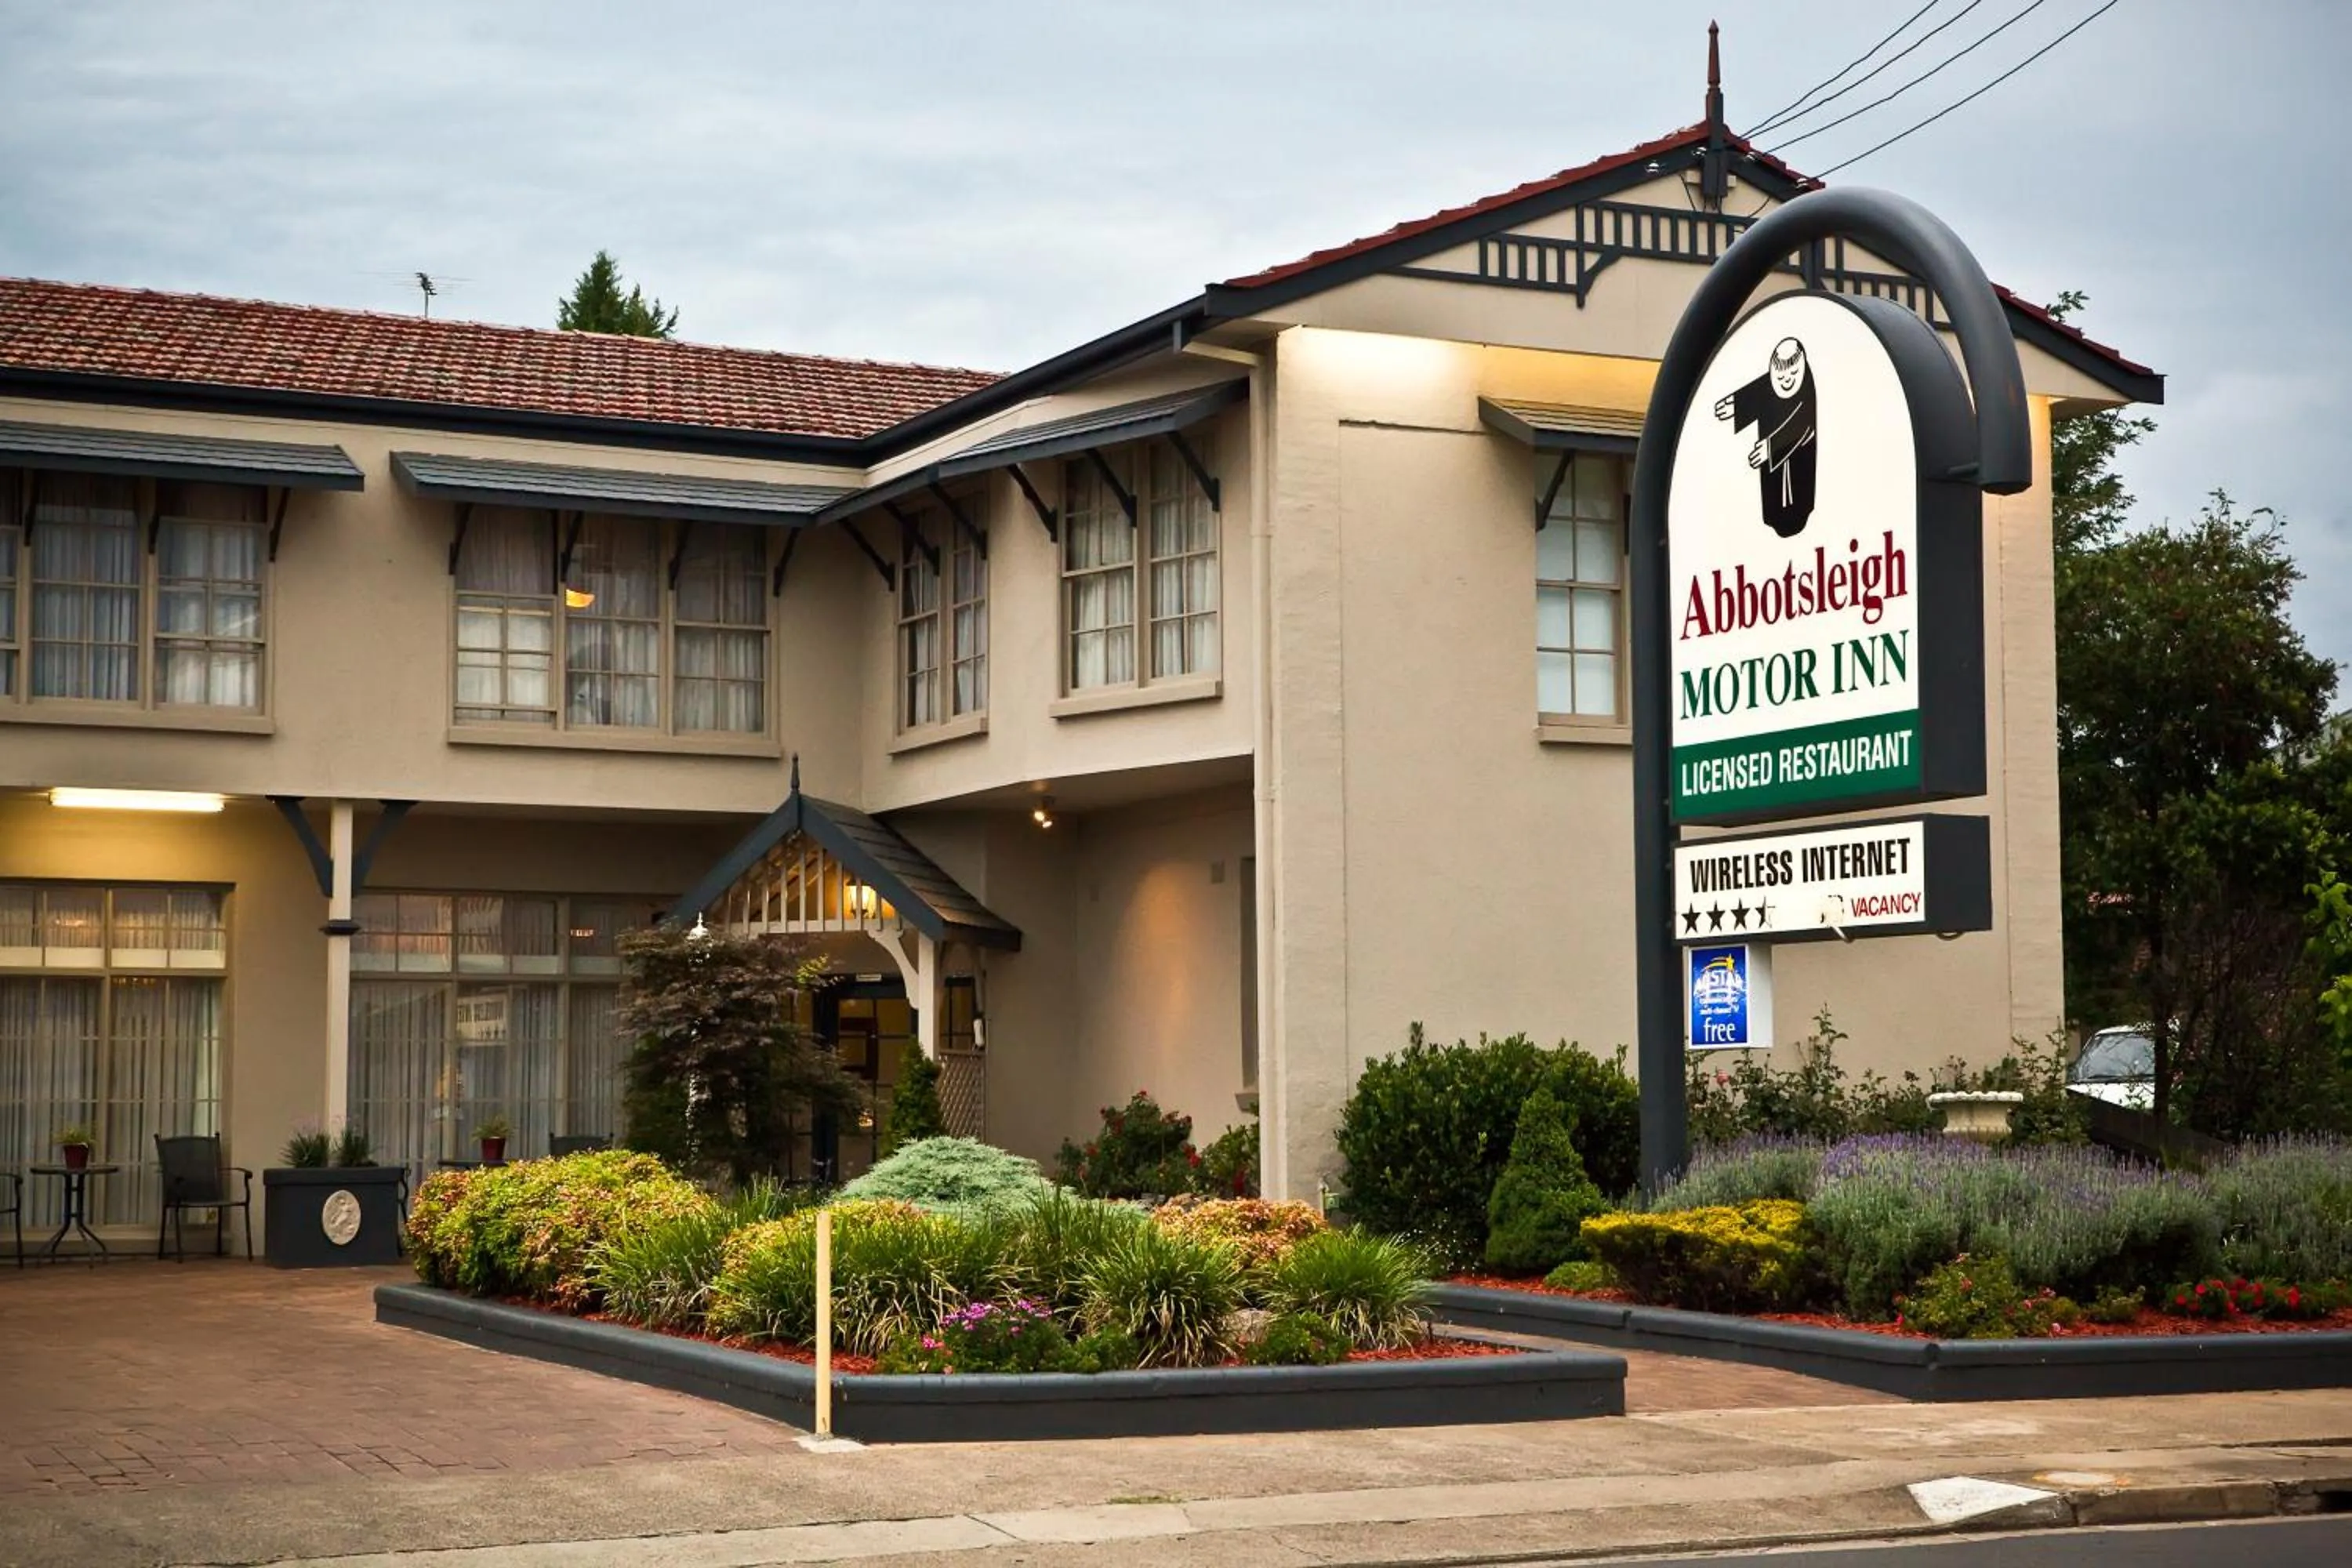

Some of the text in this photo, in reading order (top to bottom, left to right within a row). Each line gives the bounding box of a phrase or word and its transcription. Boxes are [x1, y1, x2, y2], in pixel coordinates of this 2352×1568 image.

[1679, 530, 1908, 641] Abbotsleigh
[1680, 629, 1910, 720] MOTOR INN
[1682, 730, 1912, 796] LICENSED RESTAURANT
[1690, 837, 1911, 893] WIRELESS INTERNET
[1851, 891, 1922, 918] VACANCY
[1703, 1017, 1736, 1042] free
